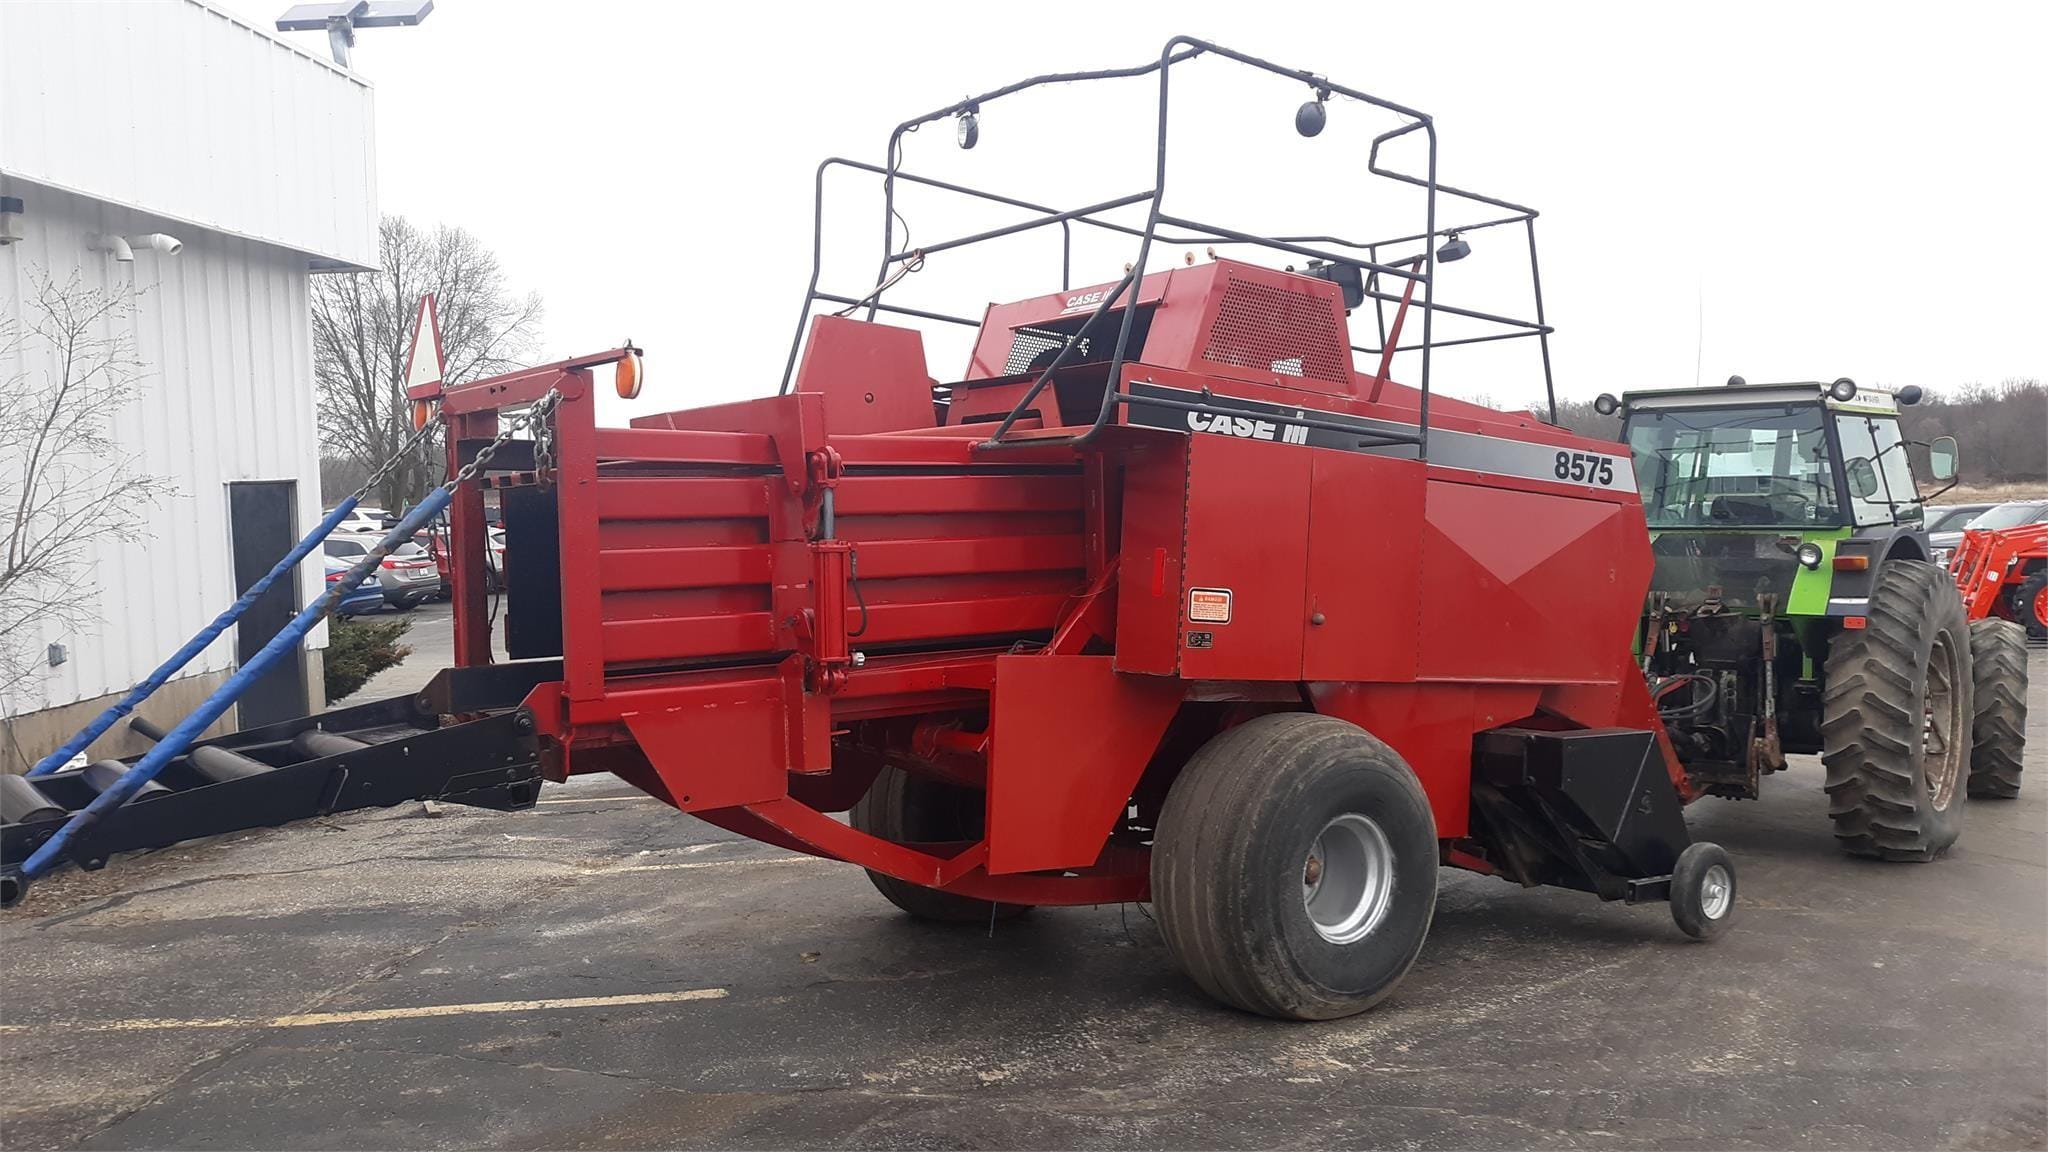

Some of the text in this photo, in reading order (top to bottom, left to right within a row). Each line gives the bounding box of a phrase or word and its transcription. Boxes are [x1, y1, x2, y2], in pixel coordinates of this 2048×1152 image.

[1066, 291, 1102, 307] CASE
[1187, 411, 1276, 440] CASE
[1555, 451, 1613, 485] 8575
